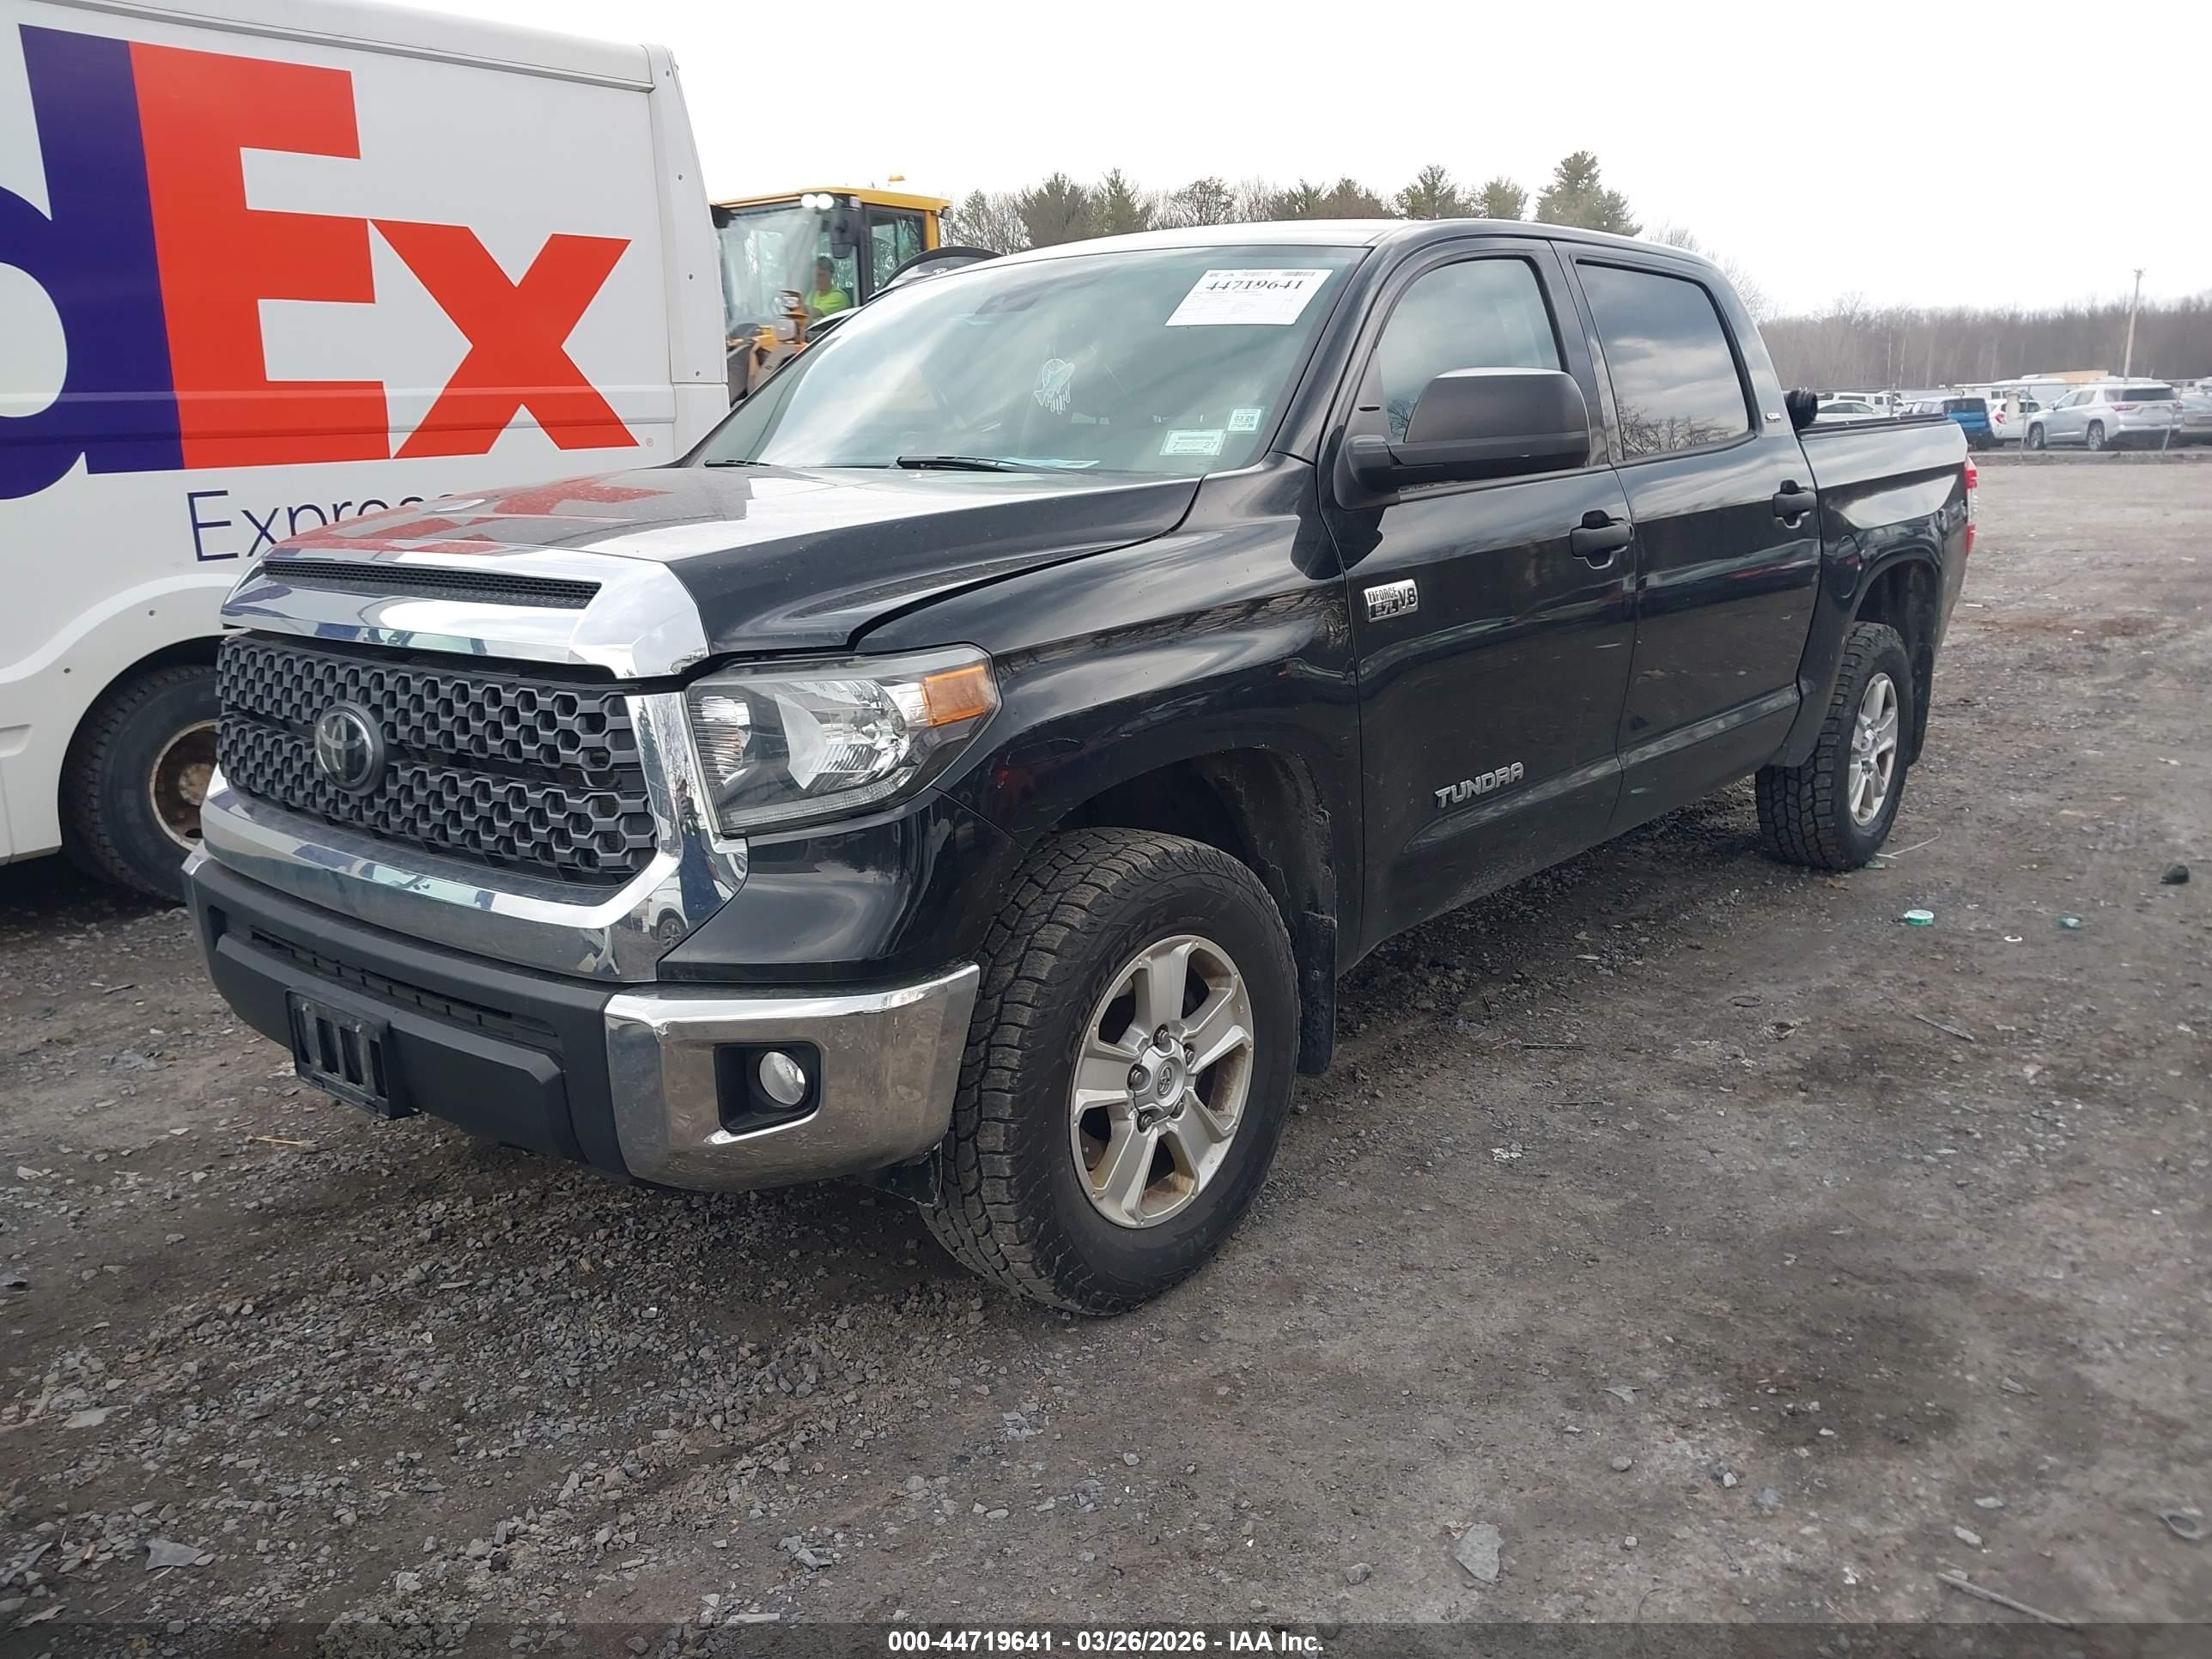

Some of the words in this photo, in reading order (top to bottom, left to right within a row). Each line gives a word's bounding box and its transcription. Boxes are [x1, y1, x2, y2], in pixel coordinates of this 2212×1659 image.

[1206, 280, 1304, 290] 44719641
[1398, 587, 1417, 607] V8
[1434, 762, 1524, 808] TUNDRA
